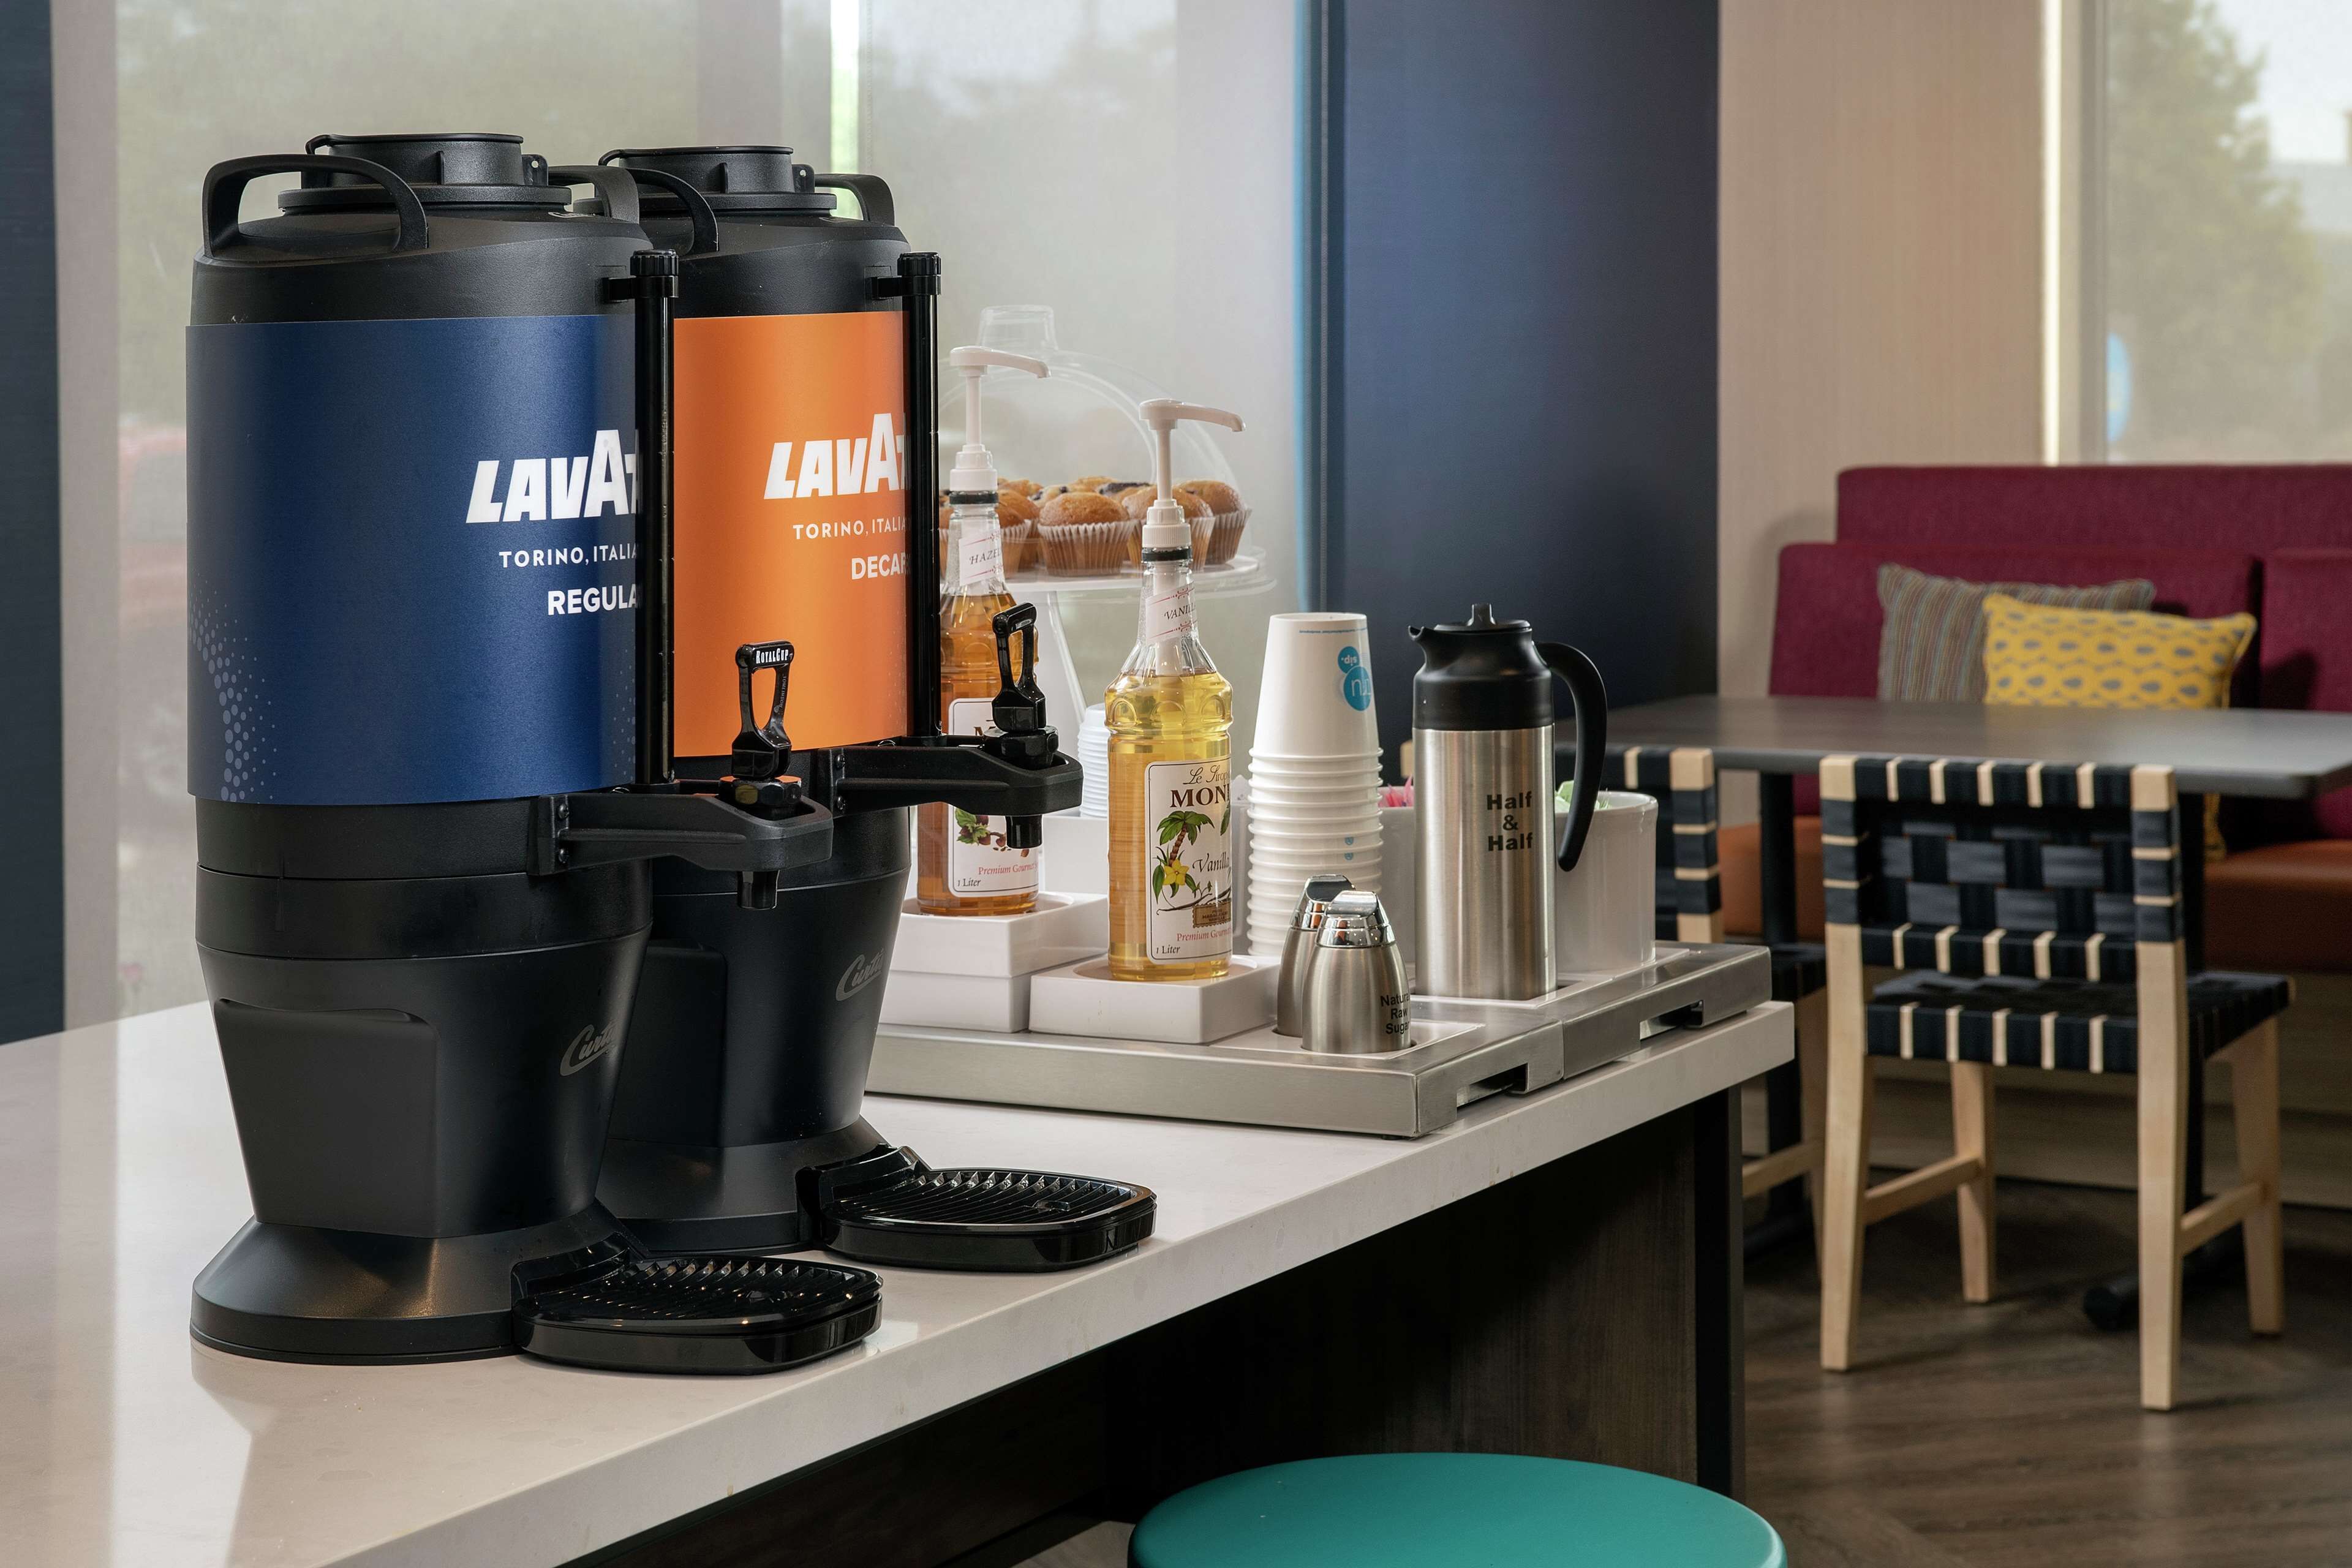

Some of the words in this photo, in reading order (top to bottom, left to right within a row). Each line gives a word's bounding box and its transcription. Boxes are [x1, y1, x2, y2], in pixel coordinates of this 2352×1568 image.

[793, 520, 869, 540] TORINO,
[499, 547, 590, 568] TORINO,
[1183, 767, 1204, 785] Le
[1487, 791, 1532, 810] Half
[1502, 815, 1518, 831] &
[1488, 832, 1533, 851] Half
[978, 865, 1011, 875] Premium
[963, 877, 981, 887] Liter
[1176, 931, 1209, 941] Premium
[1162, 944, 1181, 954] Liter
[1391, 1008, 1408, 1019] Raw
